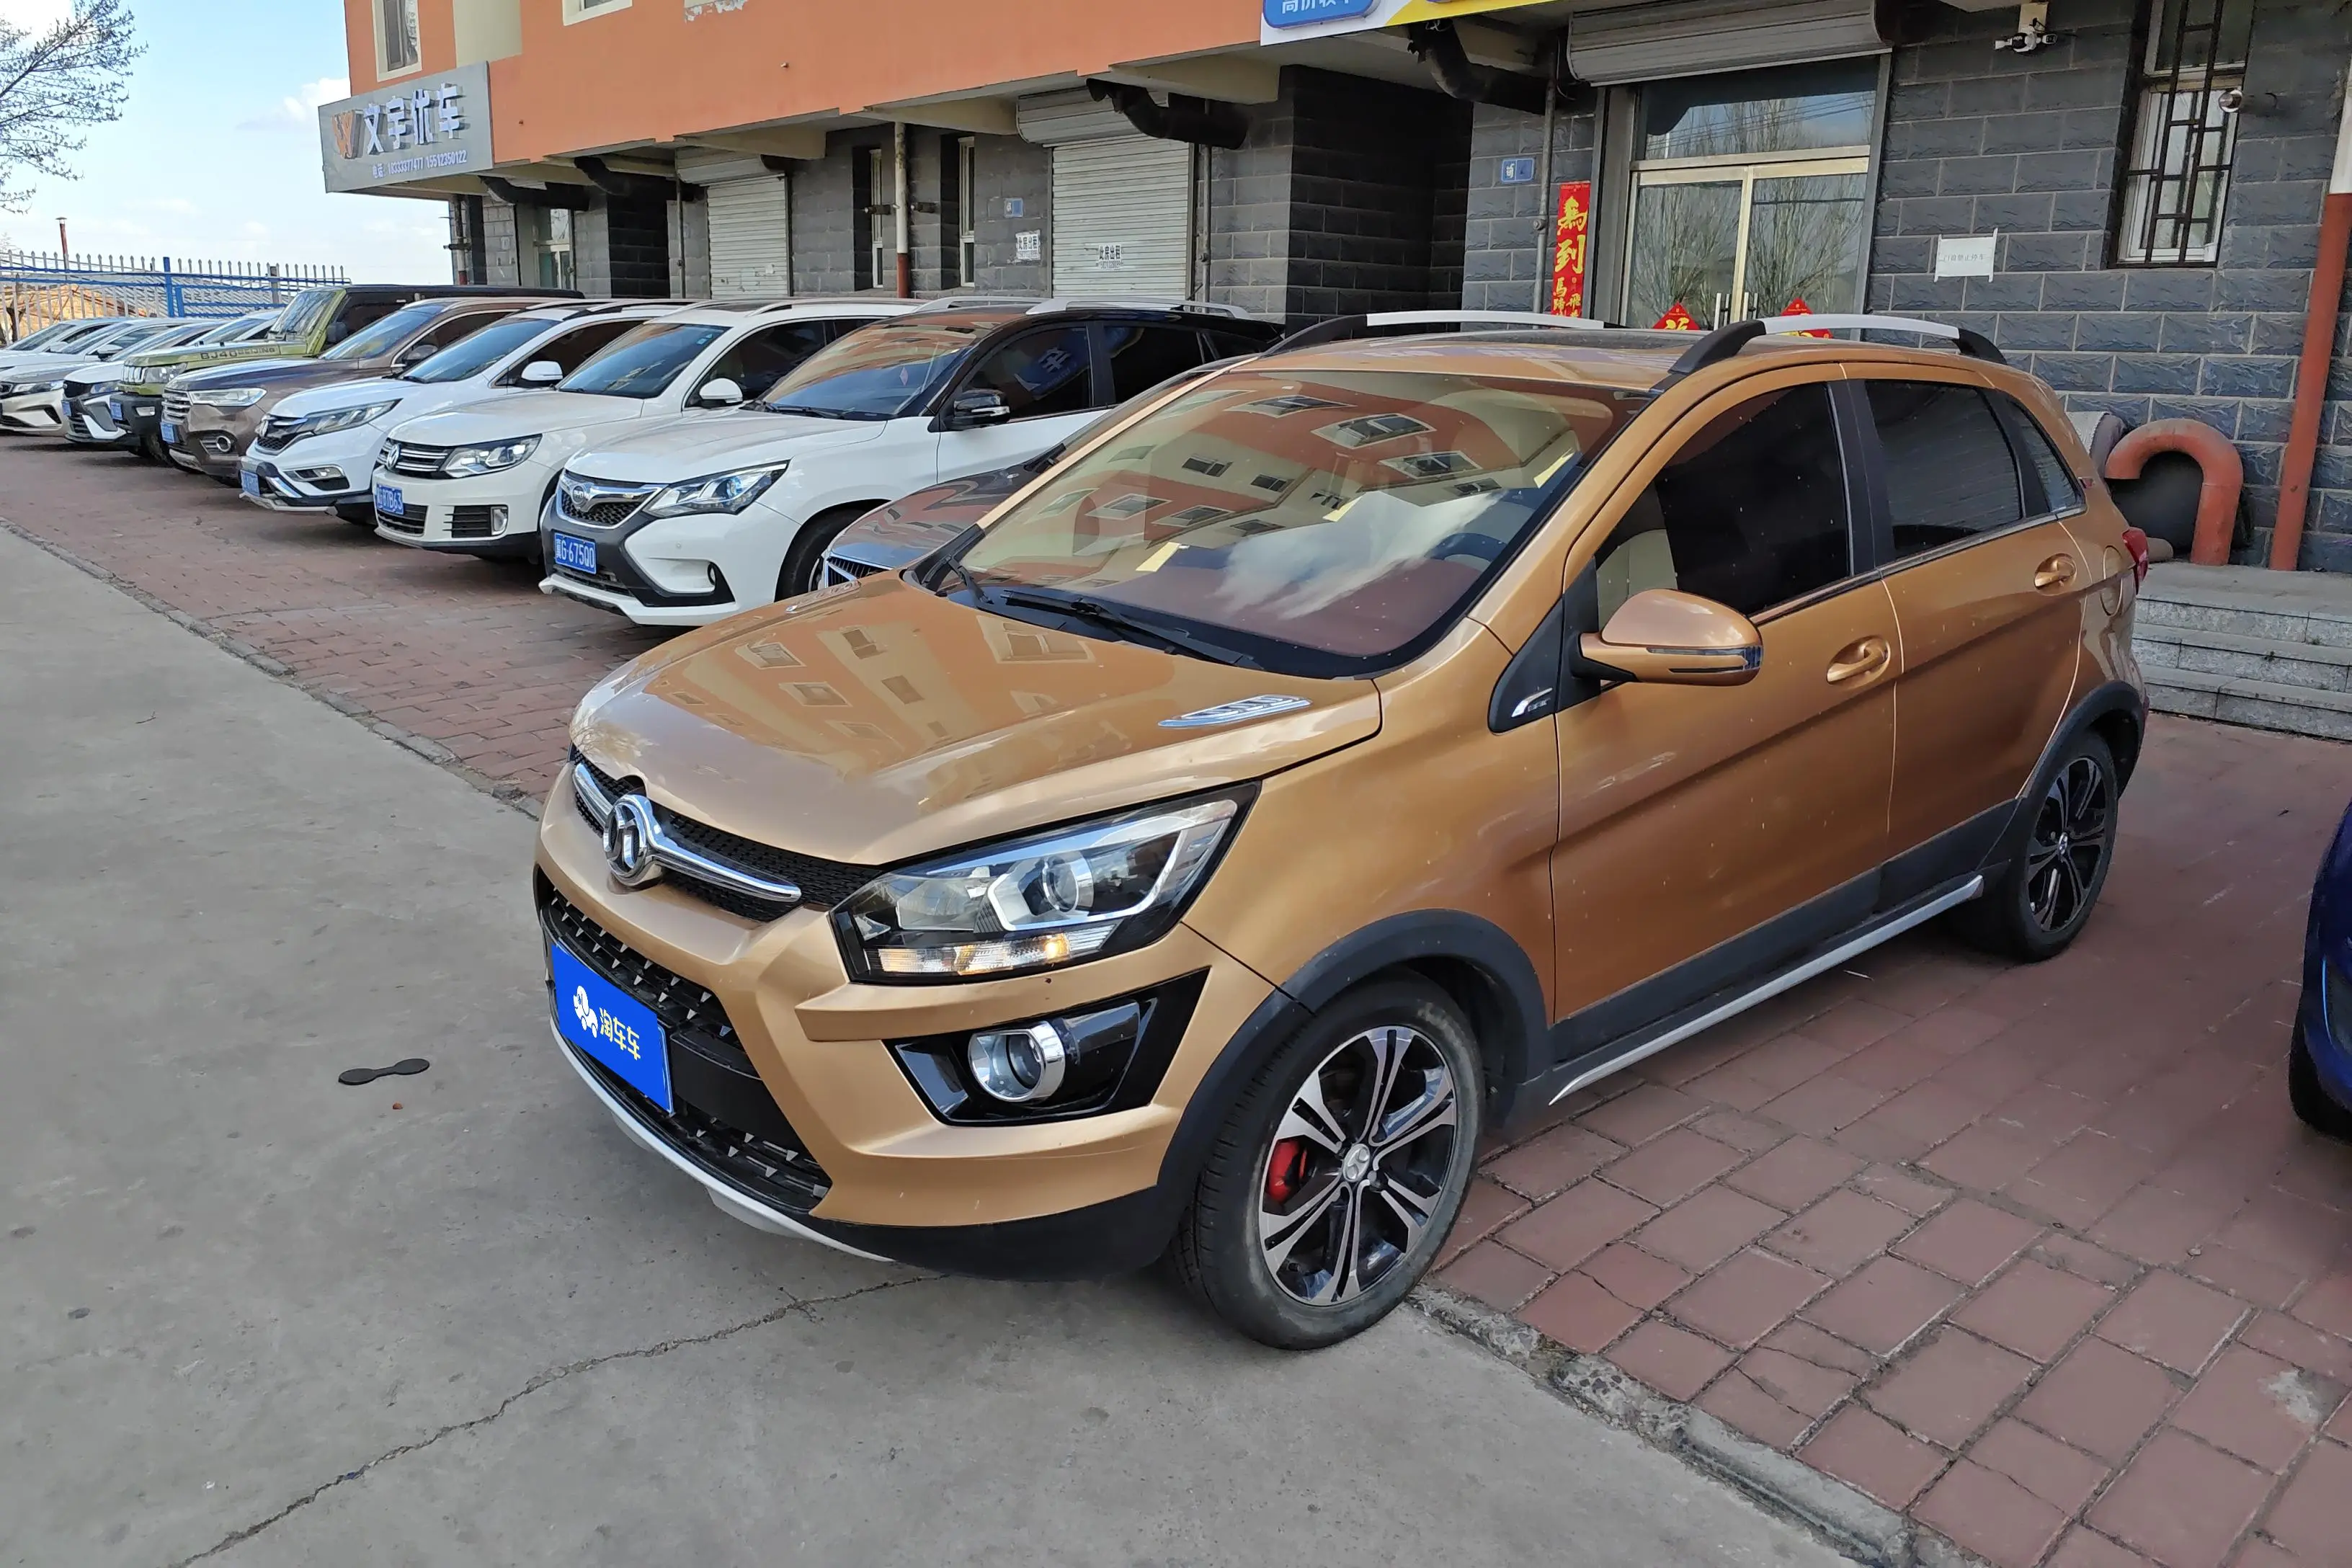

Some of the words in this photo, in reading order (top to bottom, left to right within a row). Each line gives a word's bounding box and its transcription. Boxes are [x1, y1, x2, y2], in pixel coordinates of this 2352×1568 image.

[1099, 245, 1121, 260] 此房出租
[200, 350, 237, 360] BJ40
[574, 489, 584, 499] BYD
